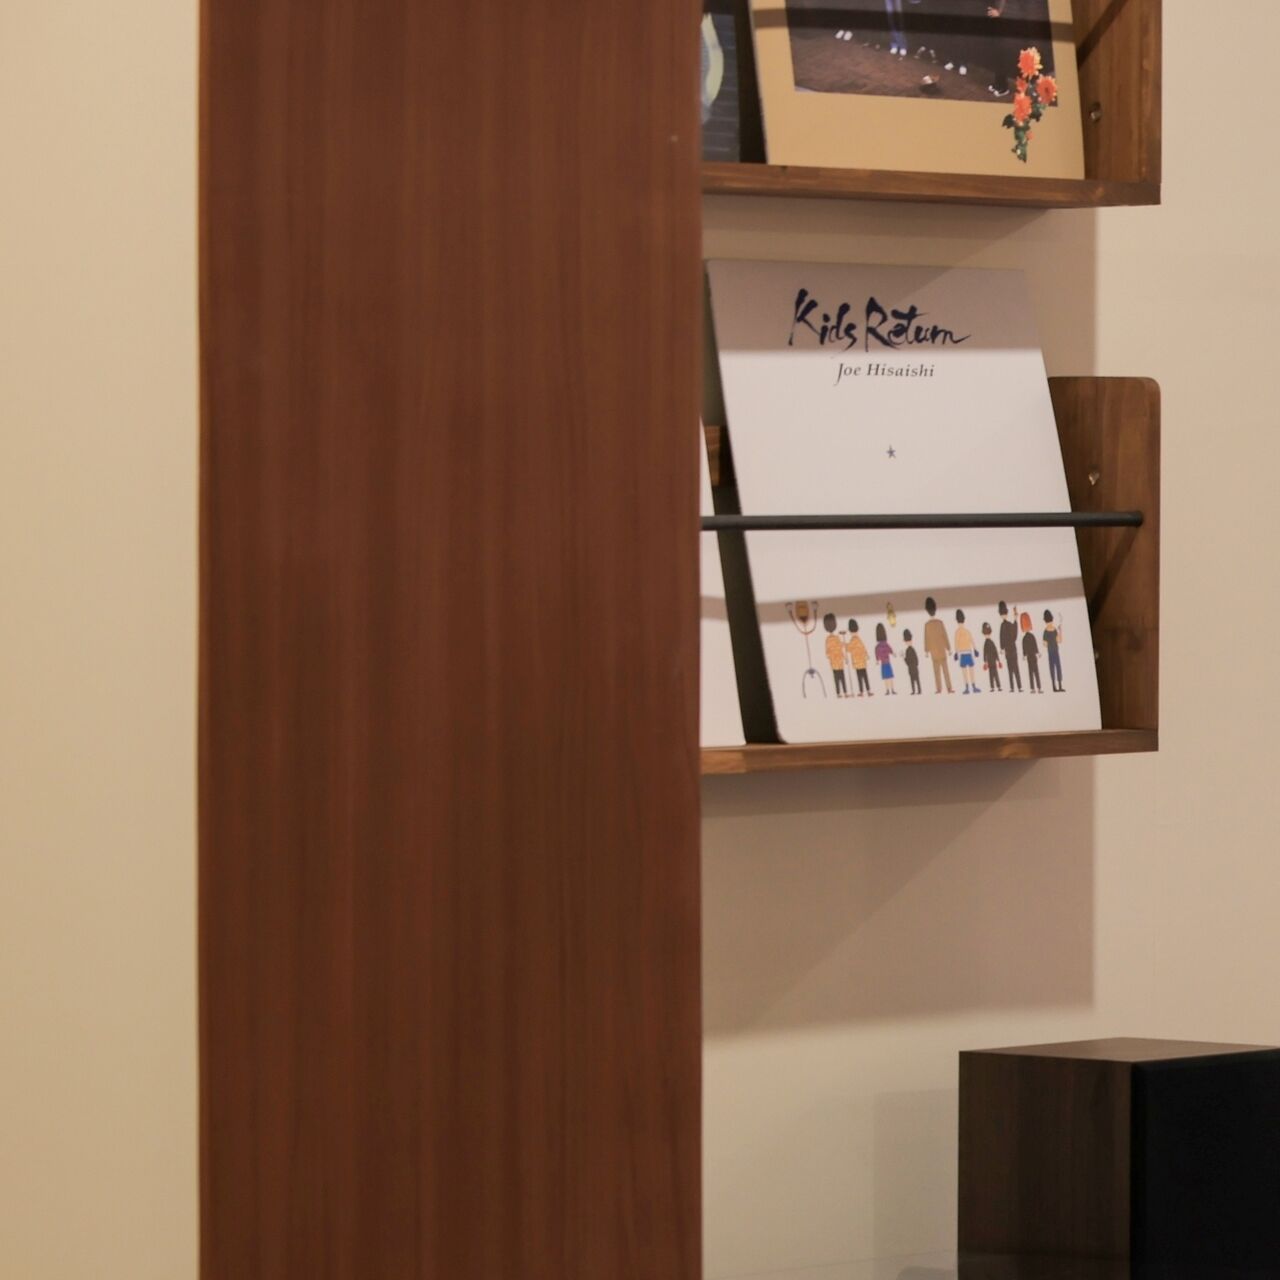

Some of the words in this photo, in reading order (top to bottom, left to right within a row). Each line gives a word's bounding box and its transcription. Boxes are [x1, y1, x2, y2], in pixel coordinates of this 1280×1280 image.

[788, 288, 857, 354] Kids
[863, 296, 972, 352] Return
[834, 363, 861, 387] Joe
[866, 363, 935, 378] Hisaishi
